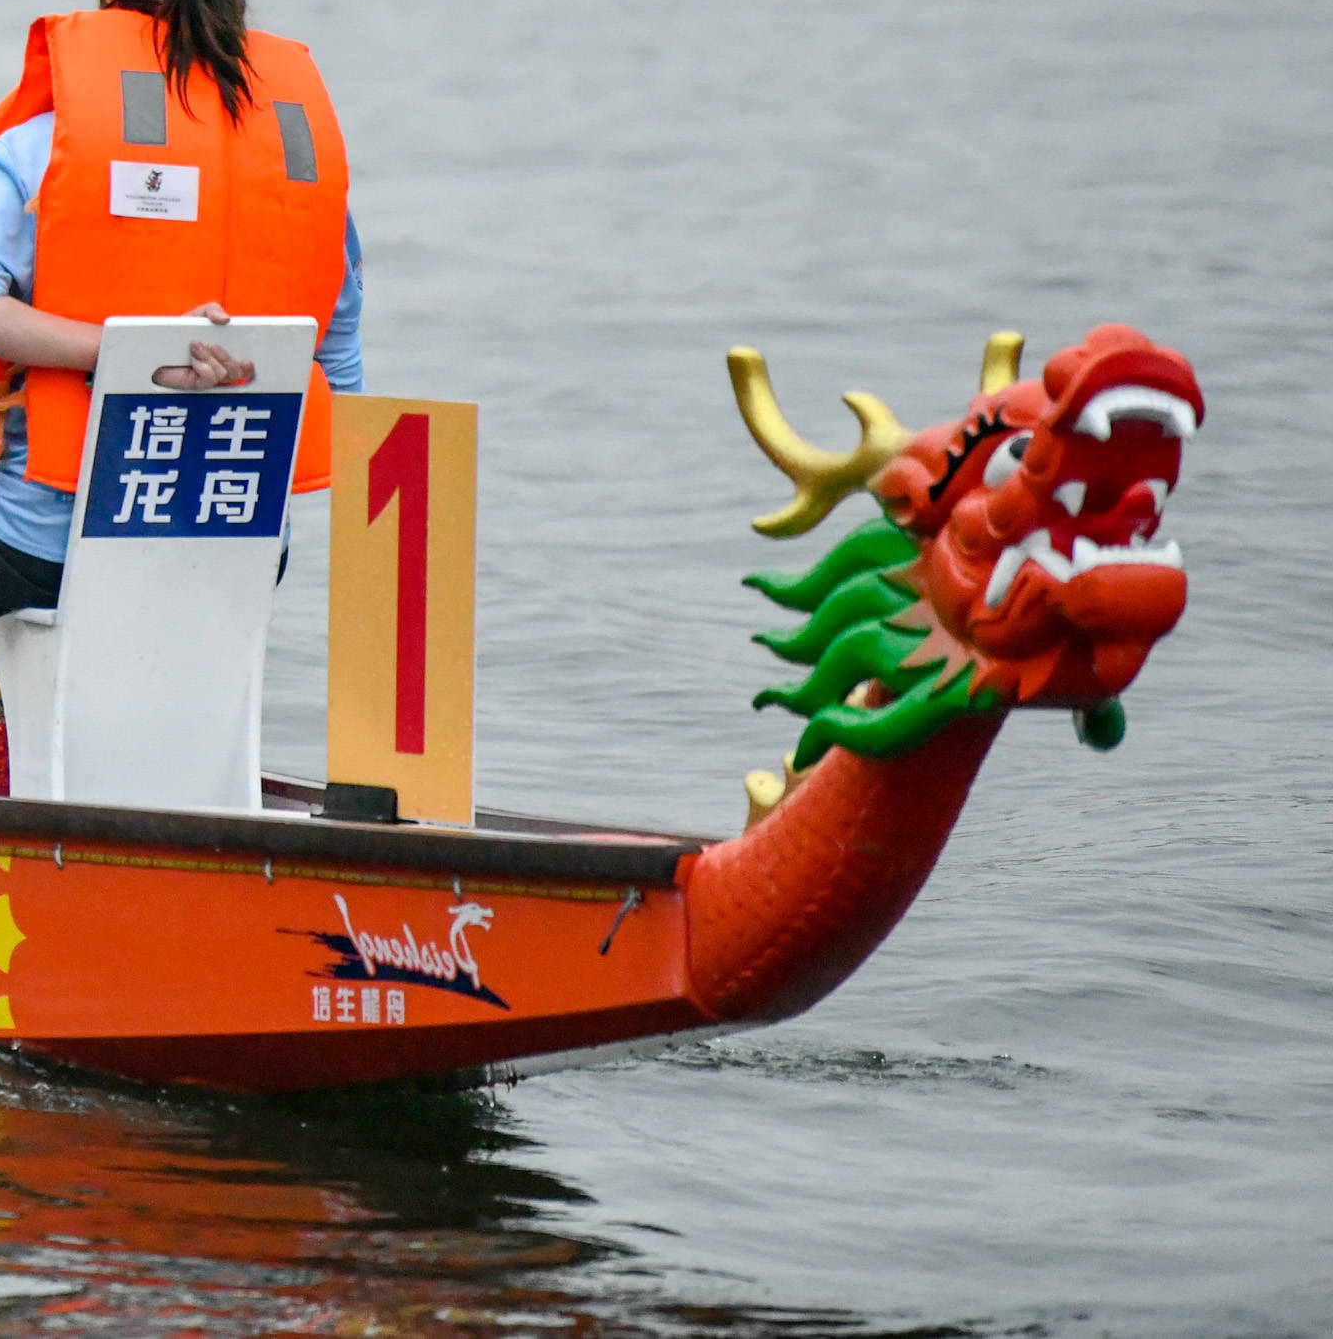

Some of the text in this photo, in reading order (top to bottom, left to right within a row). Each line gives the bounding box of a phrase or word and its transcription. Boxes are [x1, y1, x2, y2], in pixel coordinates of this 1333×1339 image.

[123, 405, 271, 460] 培生
[112, 469, 260, 524] 龙舟
[367, 412, 429, 755] 1
